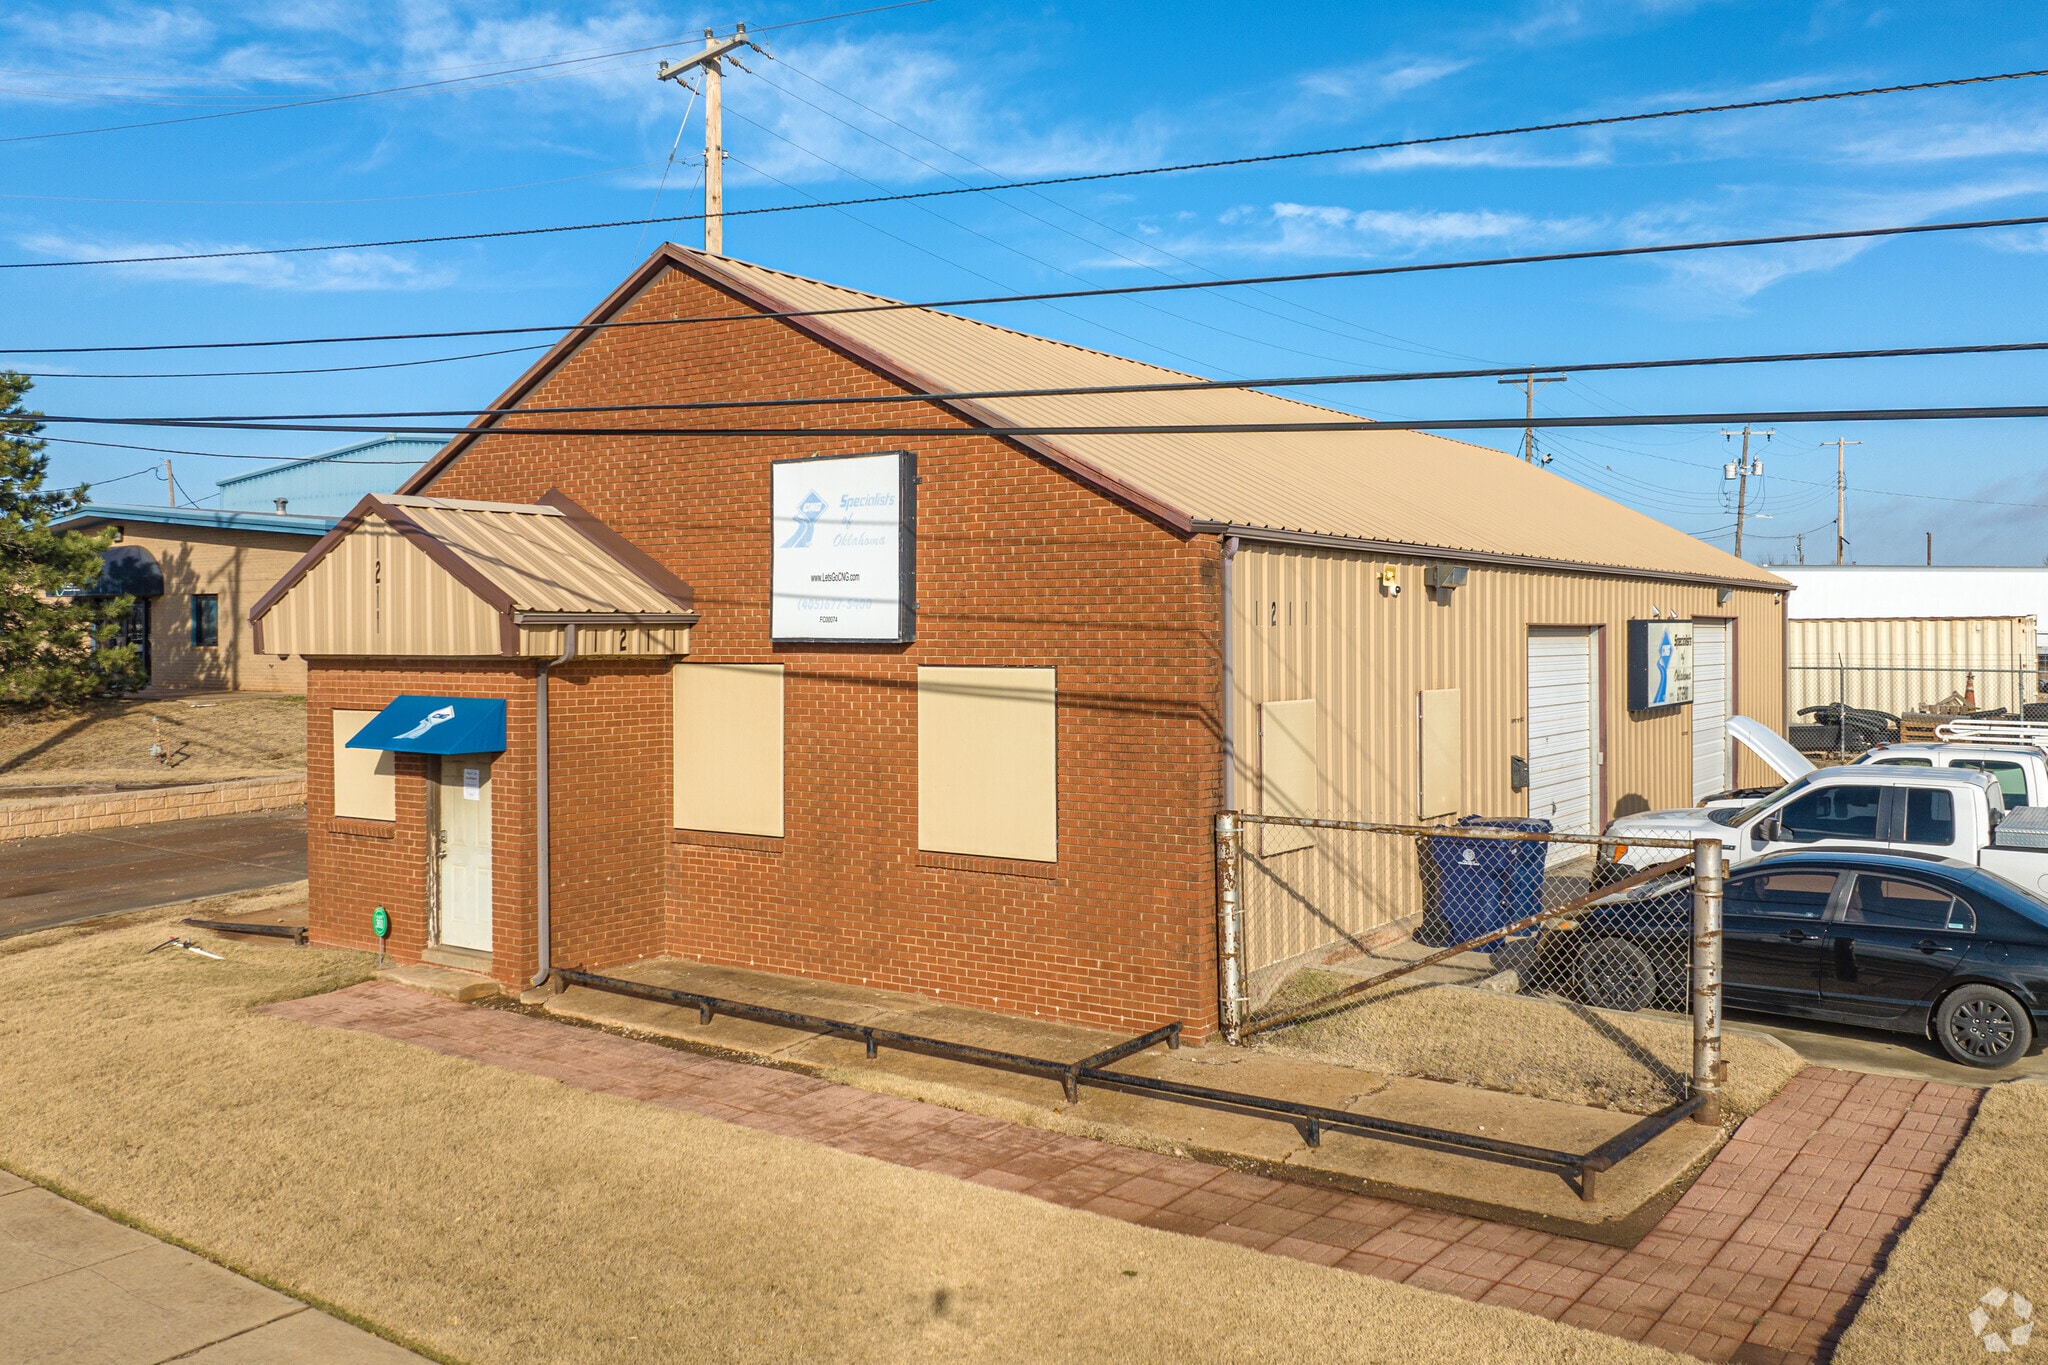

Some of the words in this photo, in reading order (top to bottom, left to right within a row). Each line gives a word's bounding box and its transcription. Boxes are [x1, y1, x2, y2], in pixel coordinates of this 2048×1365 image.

[840, 493, 896, 511] Specialists
[841, 512, 854, 530] of
[832, 532, 887, 547] Oklahoma
[810, 571, 860, 582] www.LetsGoCNG.com
